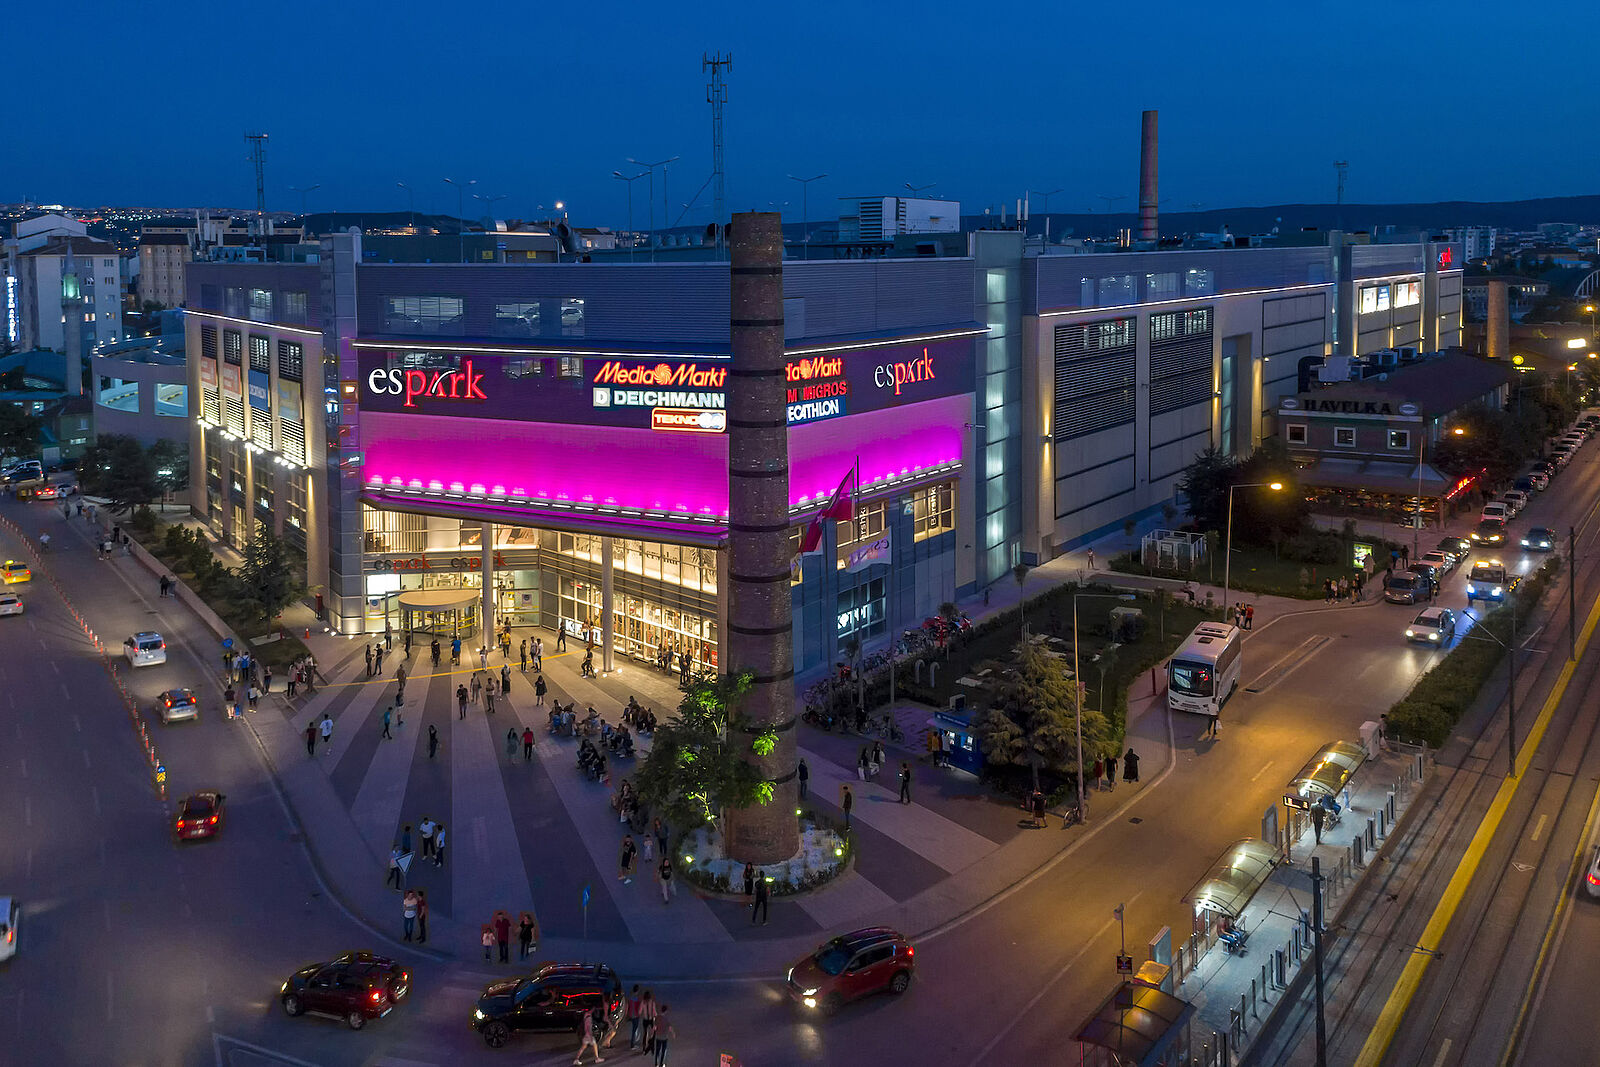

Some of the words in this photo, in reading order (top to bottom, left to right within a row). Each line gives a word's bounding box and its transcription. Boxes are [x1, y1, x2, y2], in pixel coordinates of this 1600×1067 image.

[593, 361, 655, 386] Media
[669, 363, 727, 387] Markt
[809, 356, 843, 379] Markt
[874, 348, 936, 395] espark
[368, 360, 488, 407] espark
[594, 388, 609, 406] D
[613, 390, 726, 408] DEICHMANN
[1304, 399, 1392, 414] HAVELKA
[654, 412, 724, 430] TEKNO
[788, 399, 840, 422] ECATHLON
[373, 553, 433, 573] espark
[450, 552, 508, 572] espk
